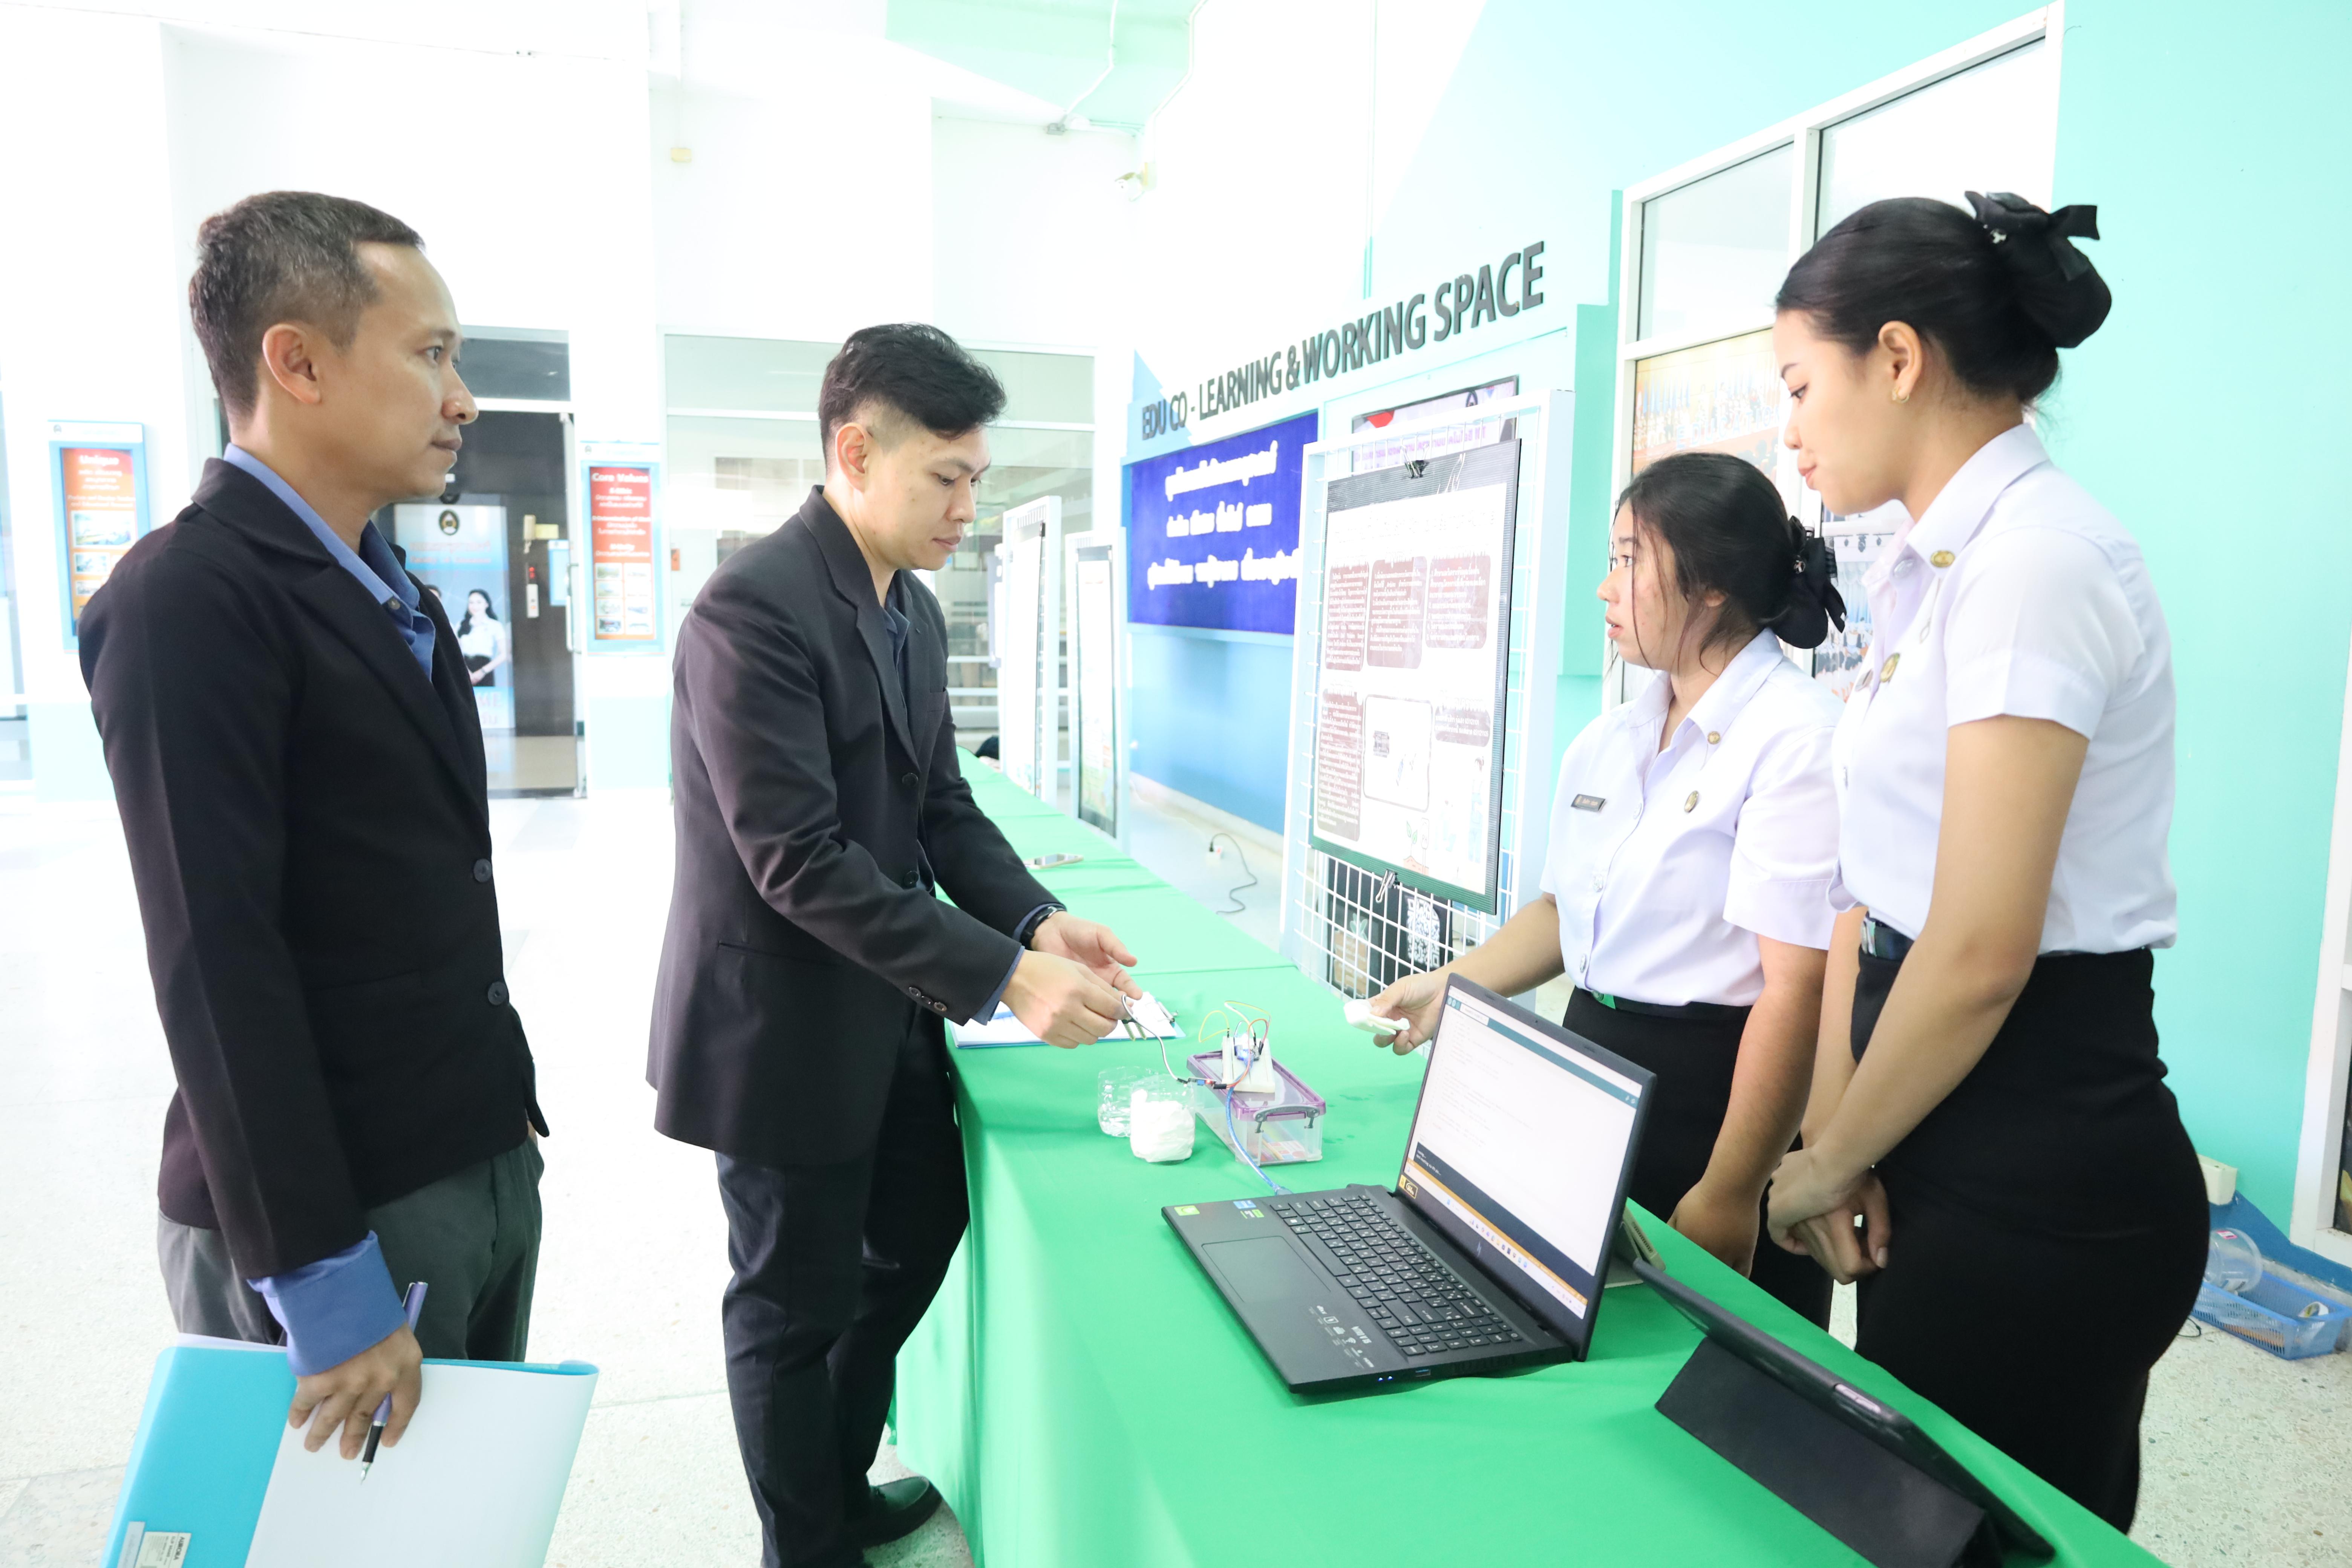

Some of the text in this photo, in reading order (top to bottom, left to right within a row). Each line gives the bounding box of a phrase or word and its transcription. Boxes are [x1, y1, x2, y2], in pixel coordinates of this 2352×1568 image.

[1142, 400, 1167, 439] EDU
[1170, 390, 1187, 431] CO
[1199, 351, 1282, 421] LEARNING
[1285, 345, 1300, 390] &
[1302, 294, 1426, 384] WORKING
[1434, 240, 1545, 341] SPACE
[592, 473, 649, 483] Core Values
